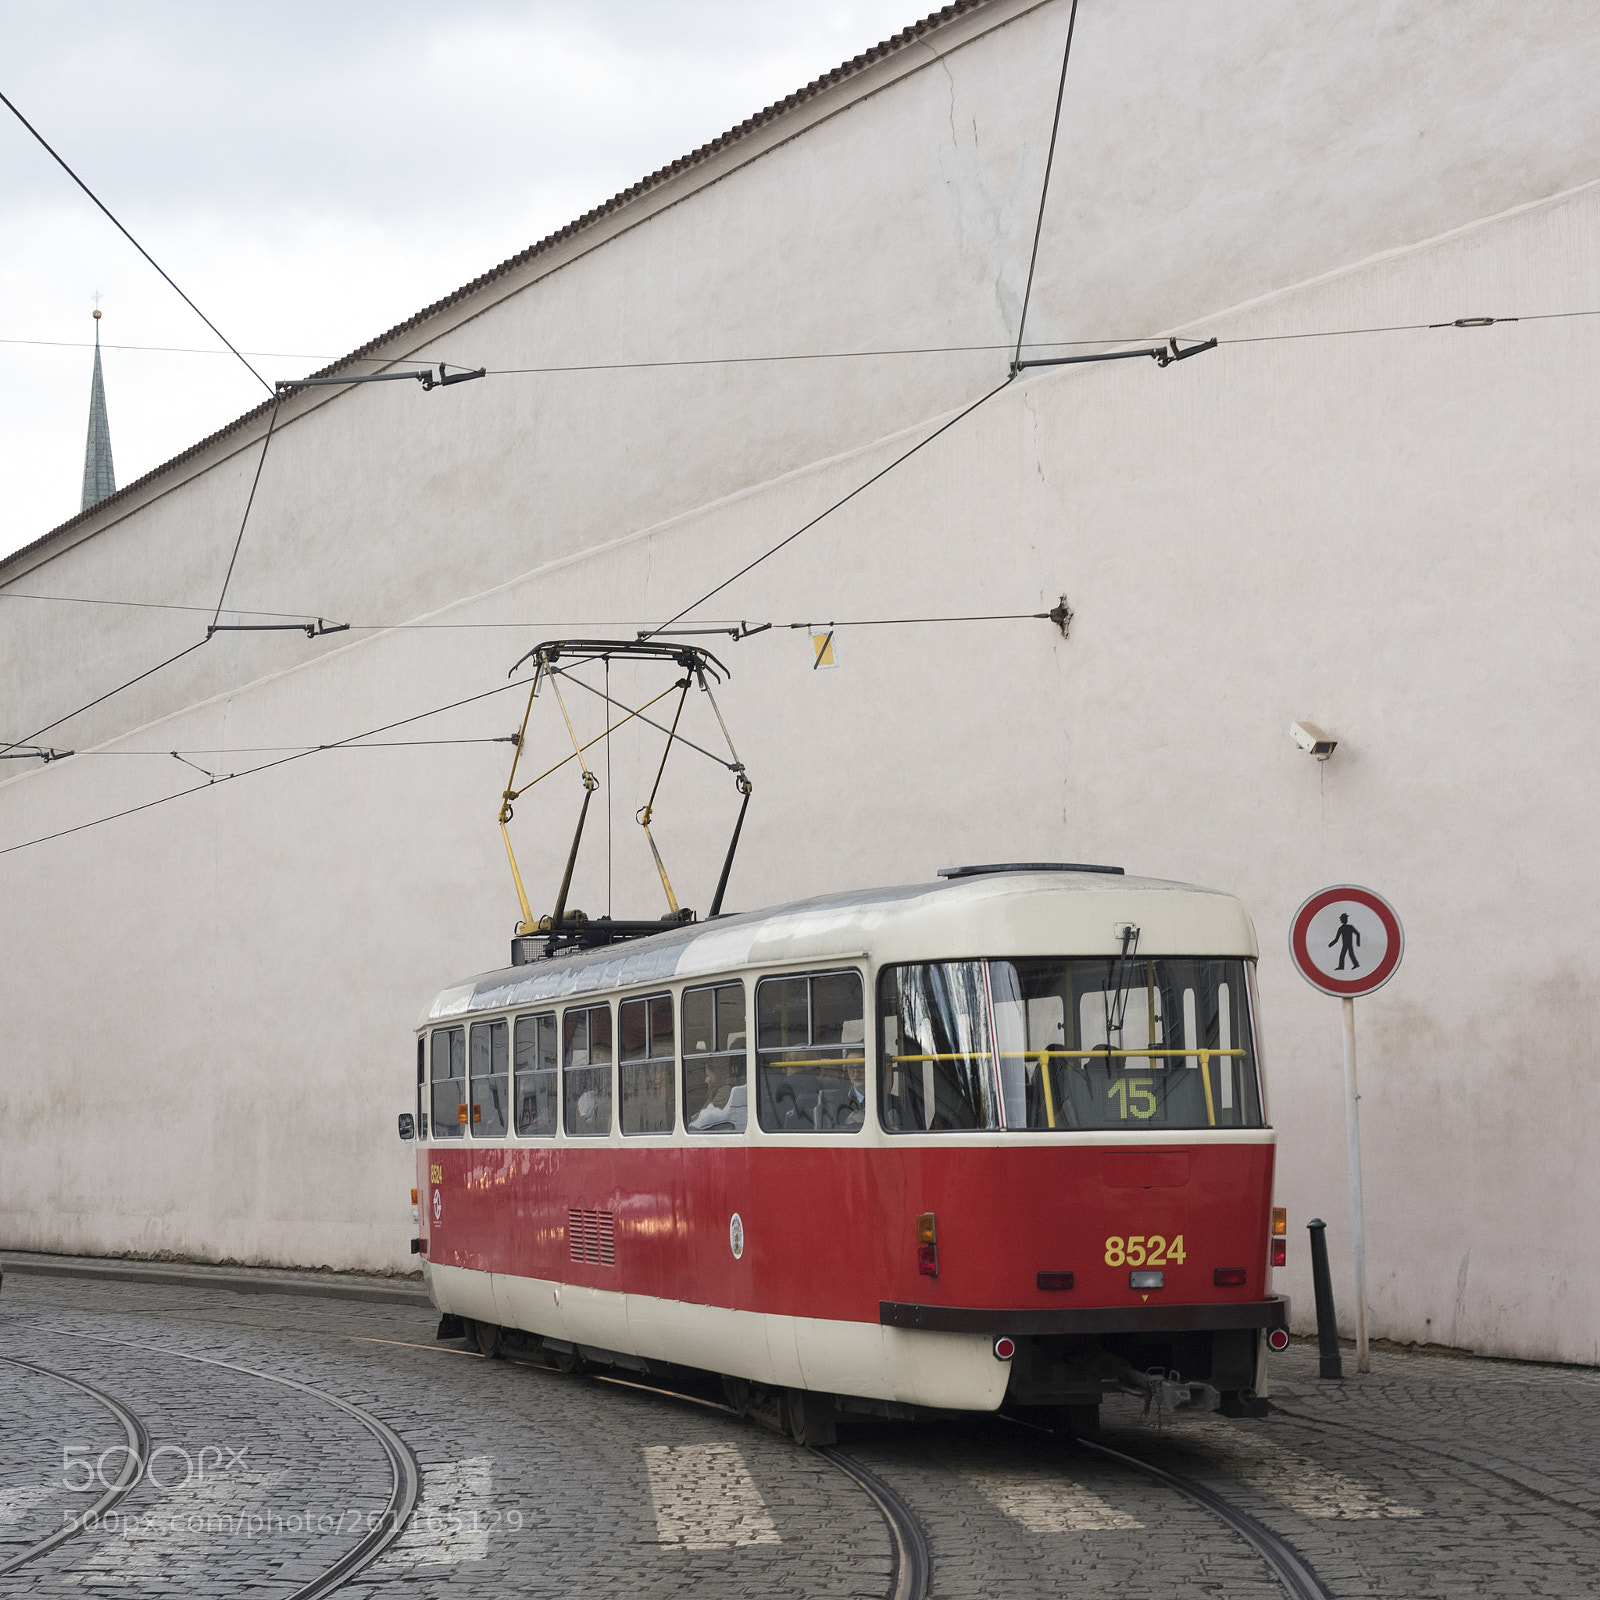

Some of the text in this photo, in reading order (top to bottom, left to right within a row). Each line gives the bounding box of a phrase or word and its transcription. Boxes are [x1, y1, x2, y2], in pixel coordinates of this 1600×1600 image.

[1107, 1078, 1157, 1119] 15
[430, 1164, 443, 1184] 8524
[1104, 1234, 1187, 1267] 8524
